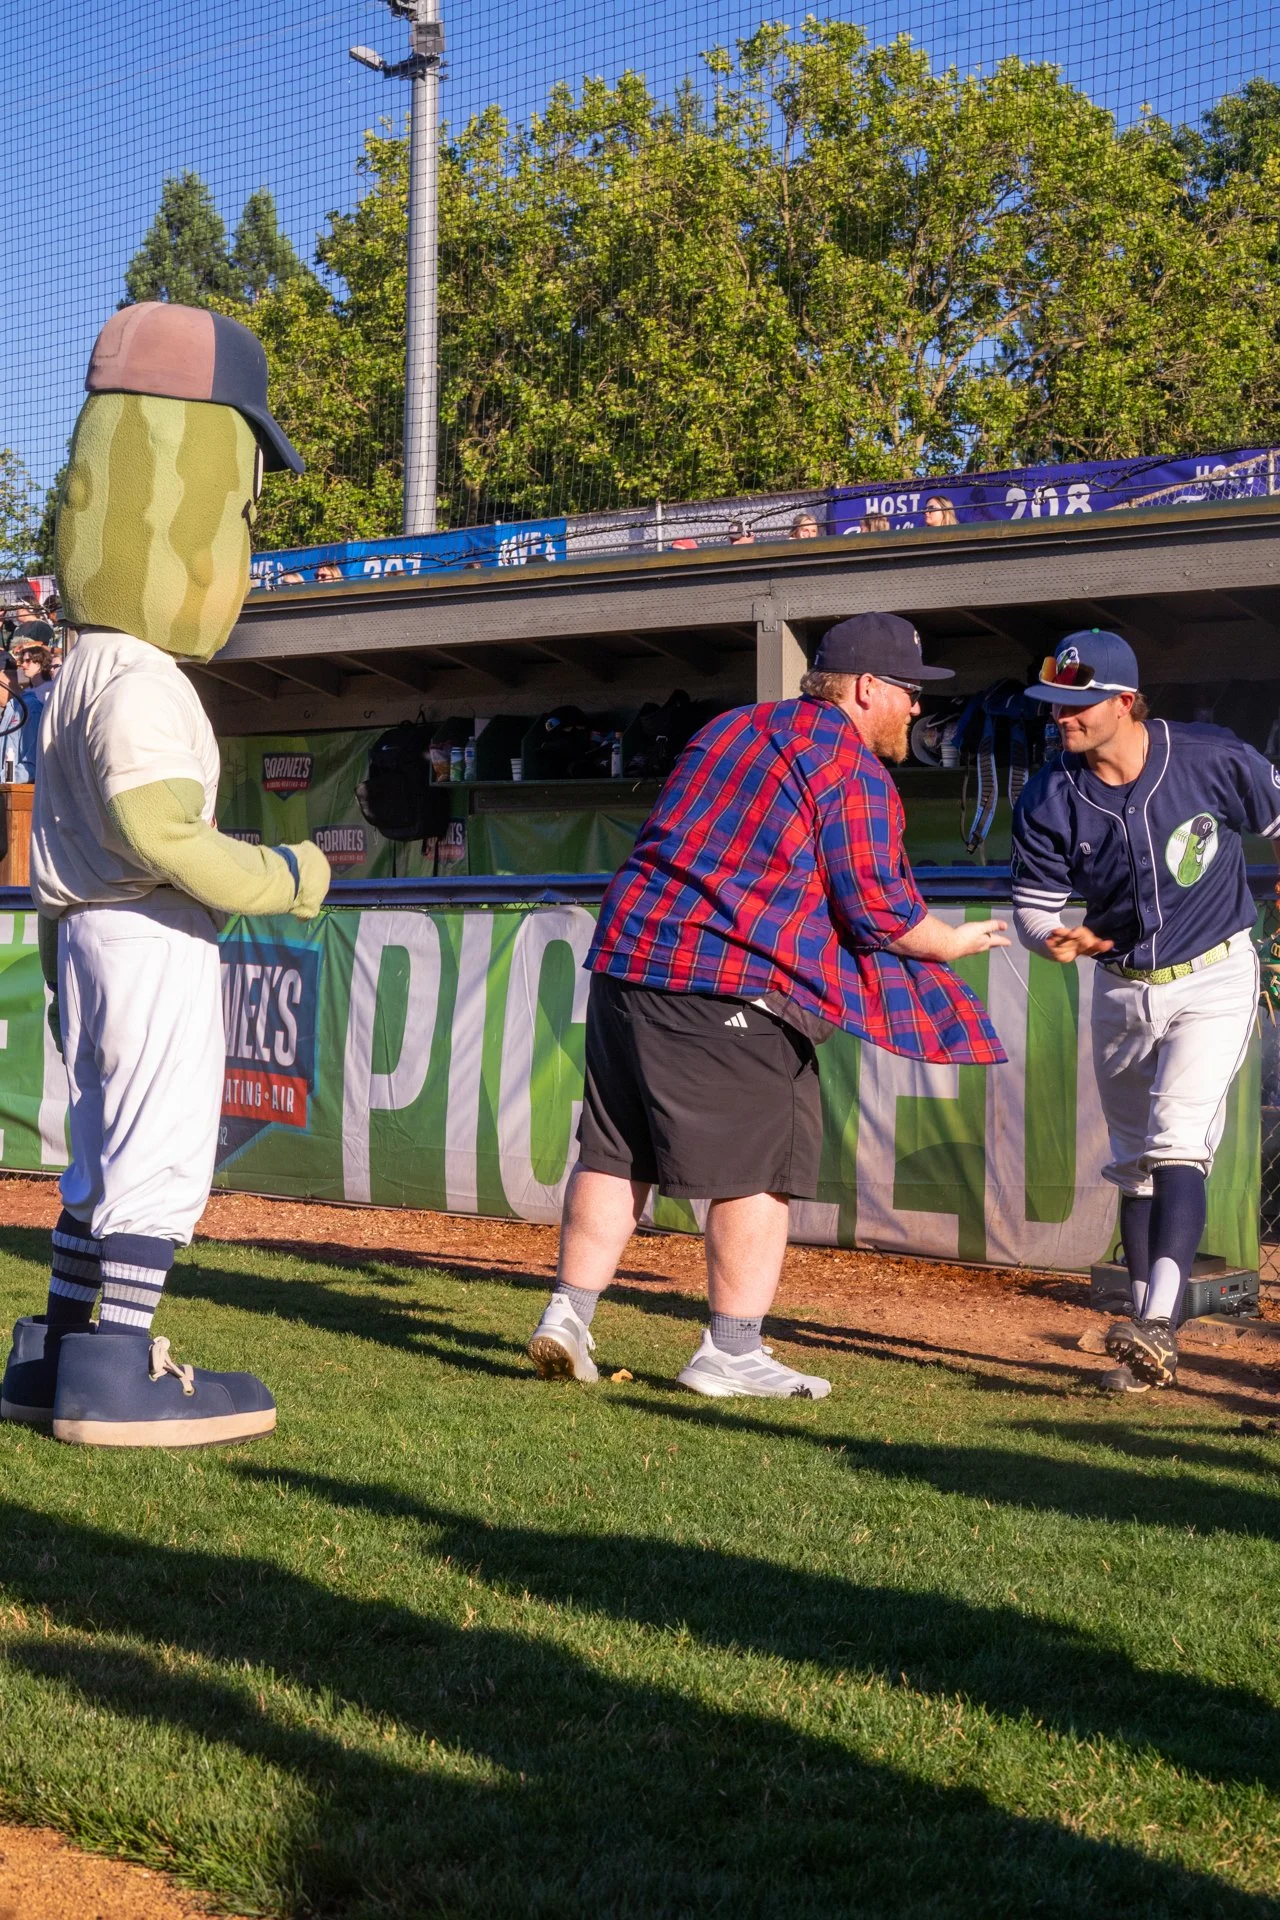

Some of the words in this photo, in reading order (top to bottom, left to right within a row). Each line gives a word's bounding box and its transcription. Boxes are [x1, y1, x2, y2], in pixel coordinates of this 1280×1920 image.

[866, 493, 921, 517] HOST
[1006, 484, 1093, 520] 208
[264, 757, 311, 779] CORNEL'S
[1202, 821, 1212, 834] P
[316, 829, 364, 852] CORNEL'S
[221, 962, 302, 1067] NEL'S
[225, 1078, 261, 1107] ATING
[271, 1084, 295, 1113] AIR
